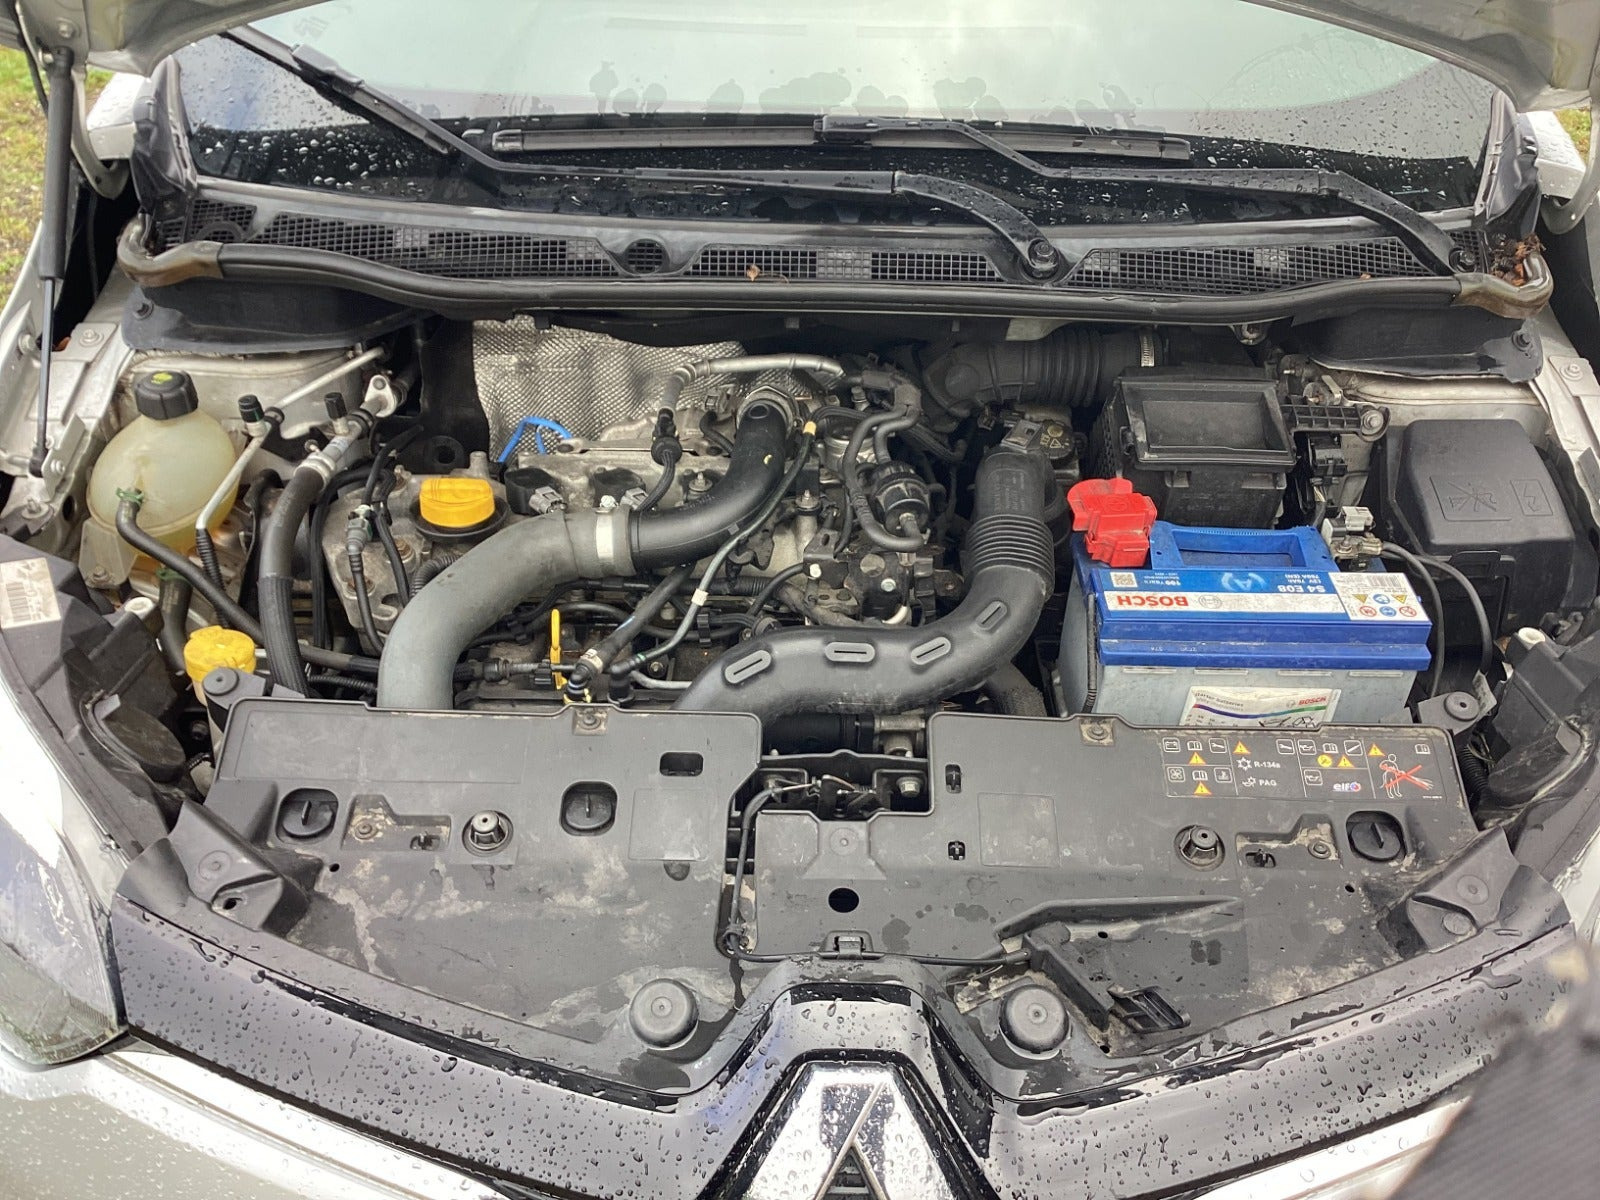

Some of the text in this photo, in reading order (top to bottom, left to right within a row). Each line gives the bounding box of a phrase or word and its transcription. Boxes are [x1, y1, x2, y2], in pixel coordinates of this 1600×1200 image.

[1307, 584, 1326, 593] S4
[1116, 595, 1189, 607] BOSCH
[1298, 696, 1327, 706] BOSCH
[1253, 761, 1281, 769] R-134a
[1258, 779, 1278, 787] PAG
[1332, 782, 1350, 791] elf
